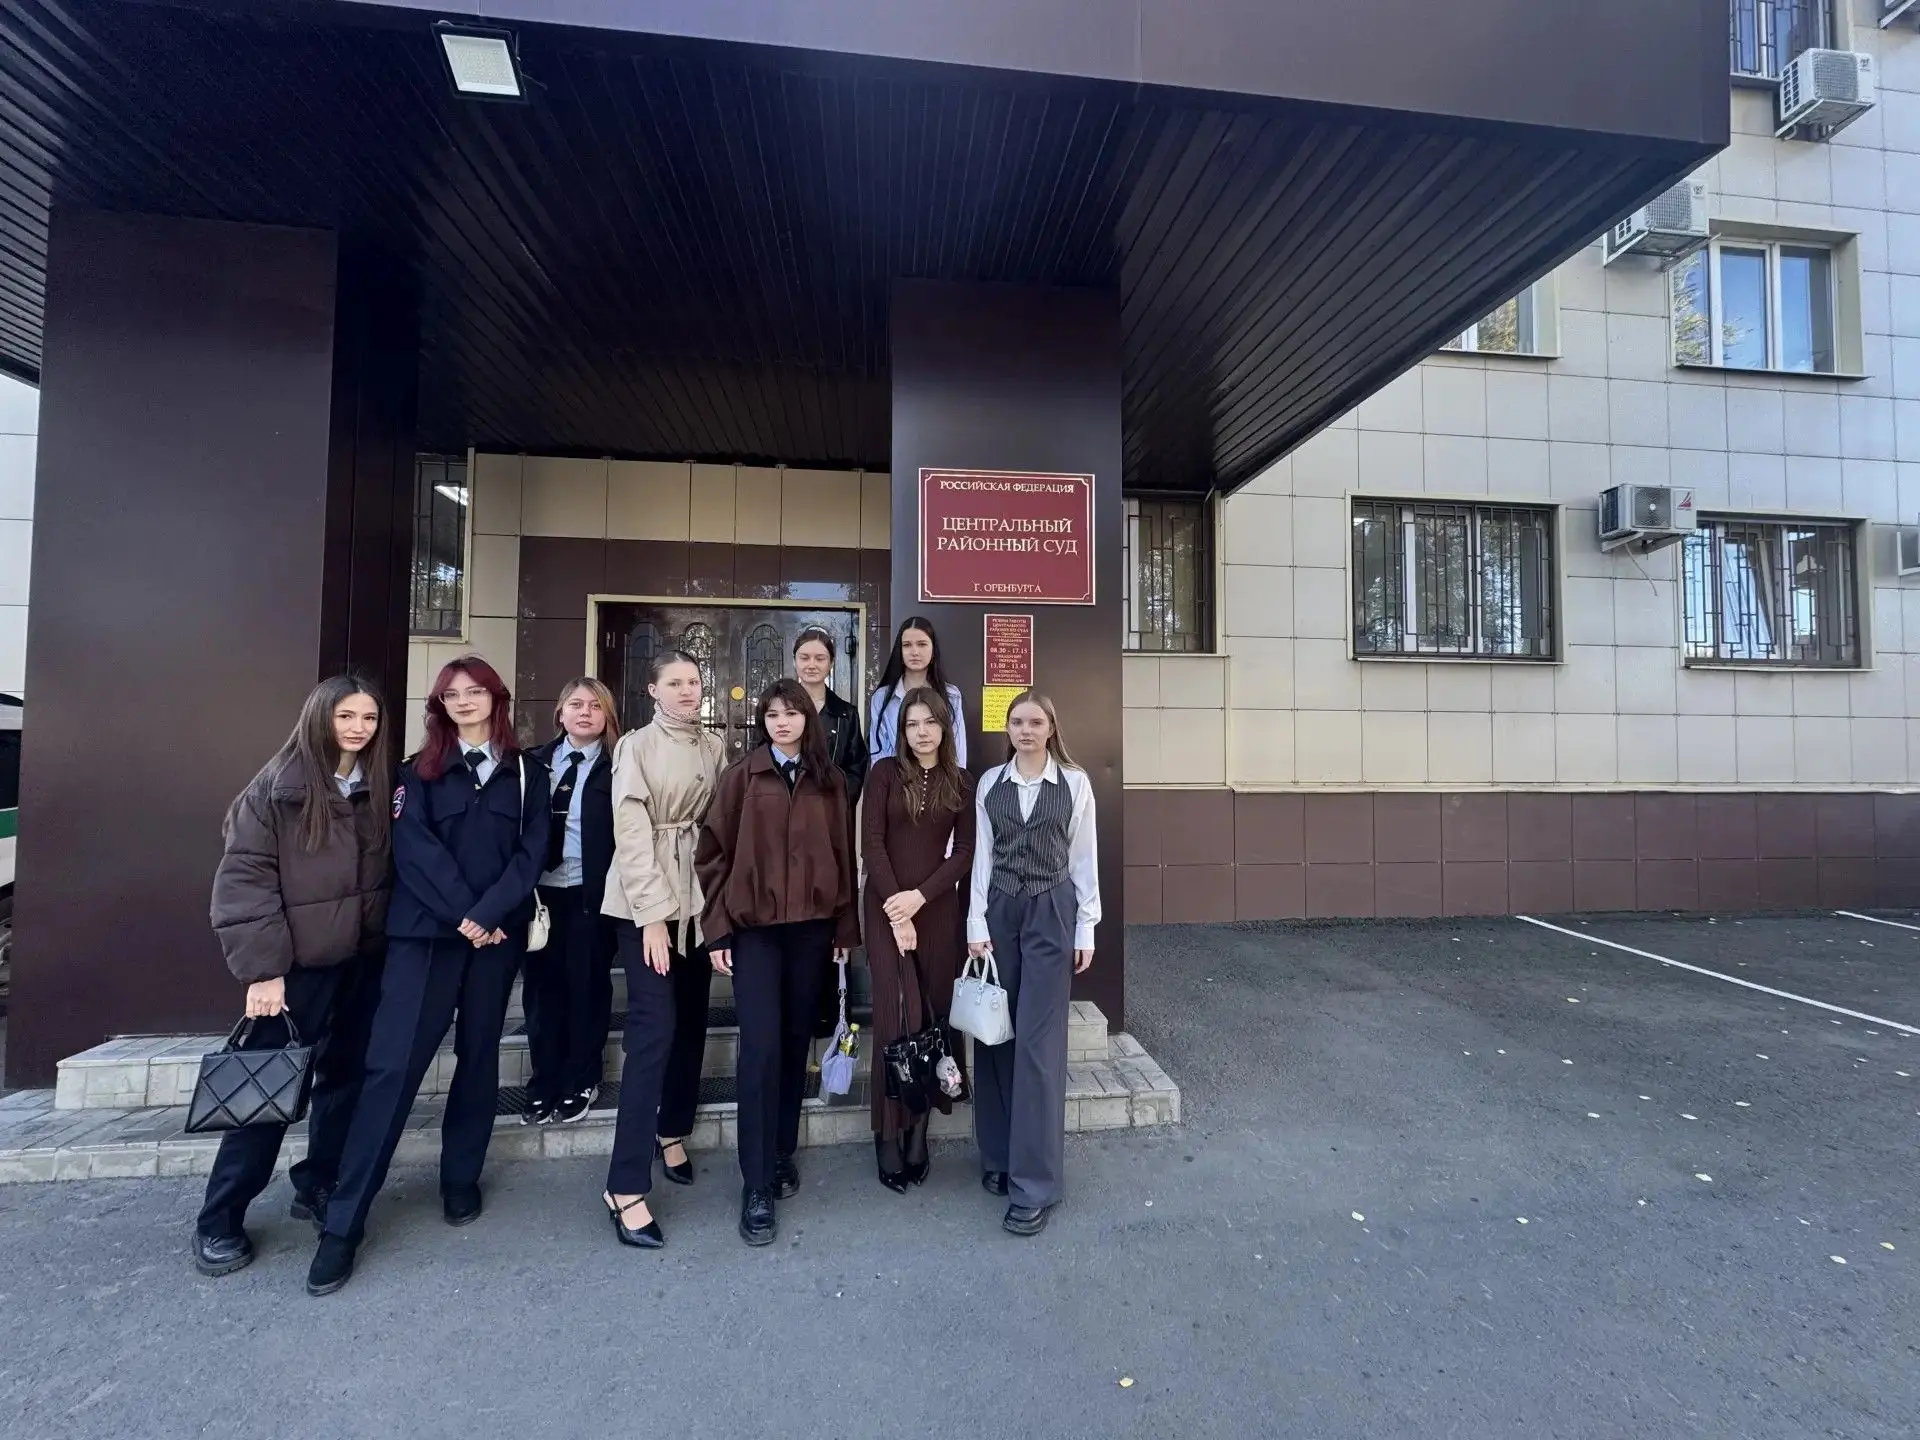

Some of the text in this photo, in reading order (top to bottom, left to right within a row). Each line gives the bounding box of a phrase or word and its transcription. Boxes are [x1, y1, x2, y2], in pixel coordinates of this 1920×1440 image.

[940, 480, 1075, 494] РОССИЙСКАЯ ФЕДЕРАЦИЯ
[942, 517, 1073, 533] ЦЕНТРАЛЬНЫЙ
[936, 535, 1079, 555] РАЙОННЫЙ СУД
[974, 583, 1042, 593] Г. ОРЕНБУРГА
